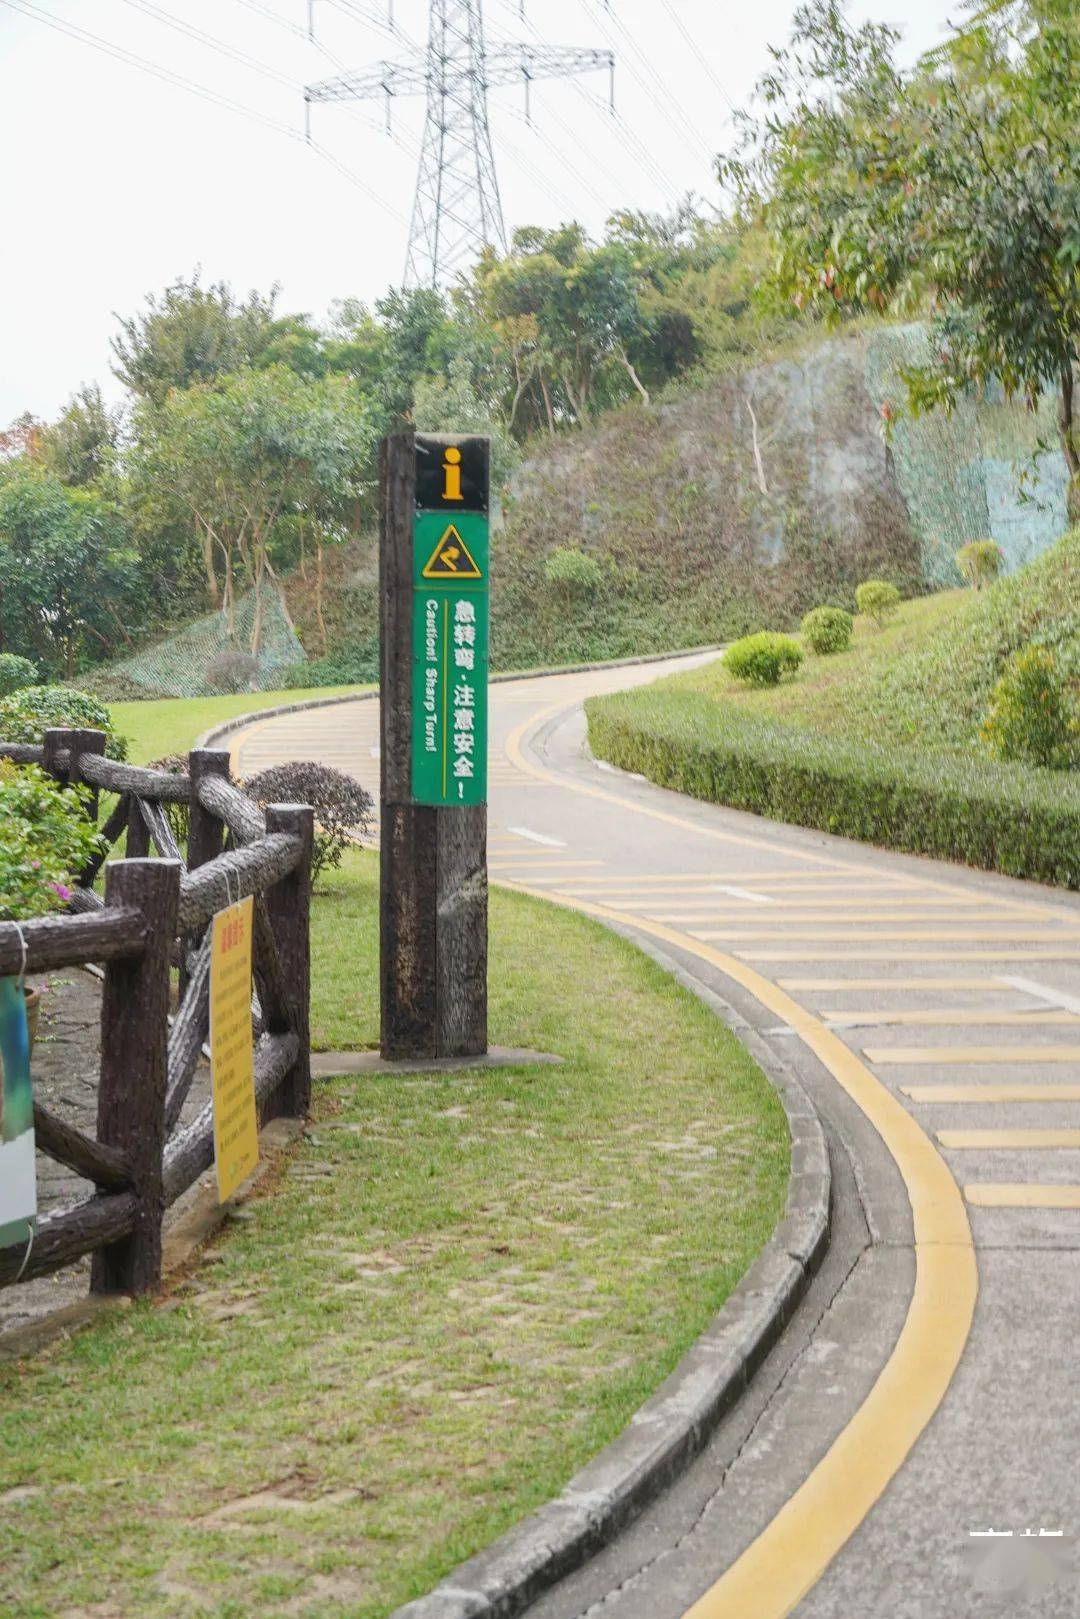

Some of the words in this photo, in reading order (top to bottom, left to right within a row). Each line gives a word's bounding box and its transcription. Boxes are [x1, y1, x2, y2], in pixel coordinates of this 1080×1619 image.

[425, 598, 439, 662] Caution!
[423, 667, 439, 711] Sharp
[424, 713, 438, 753] Turn!
